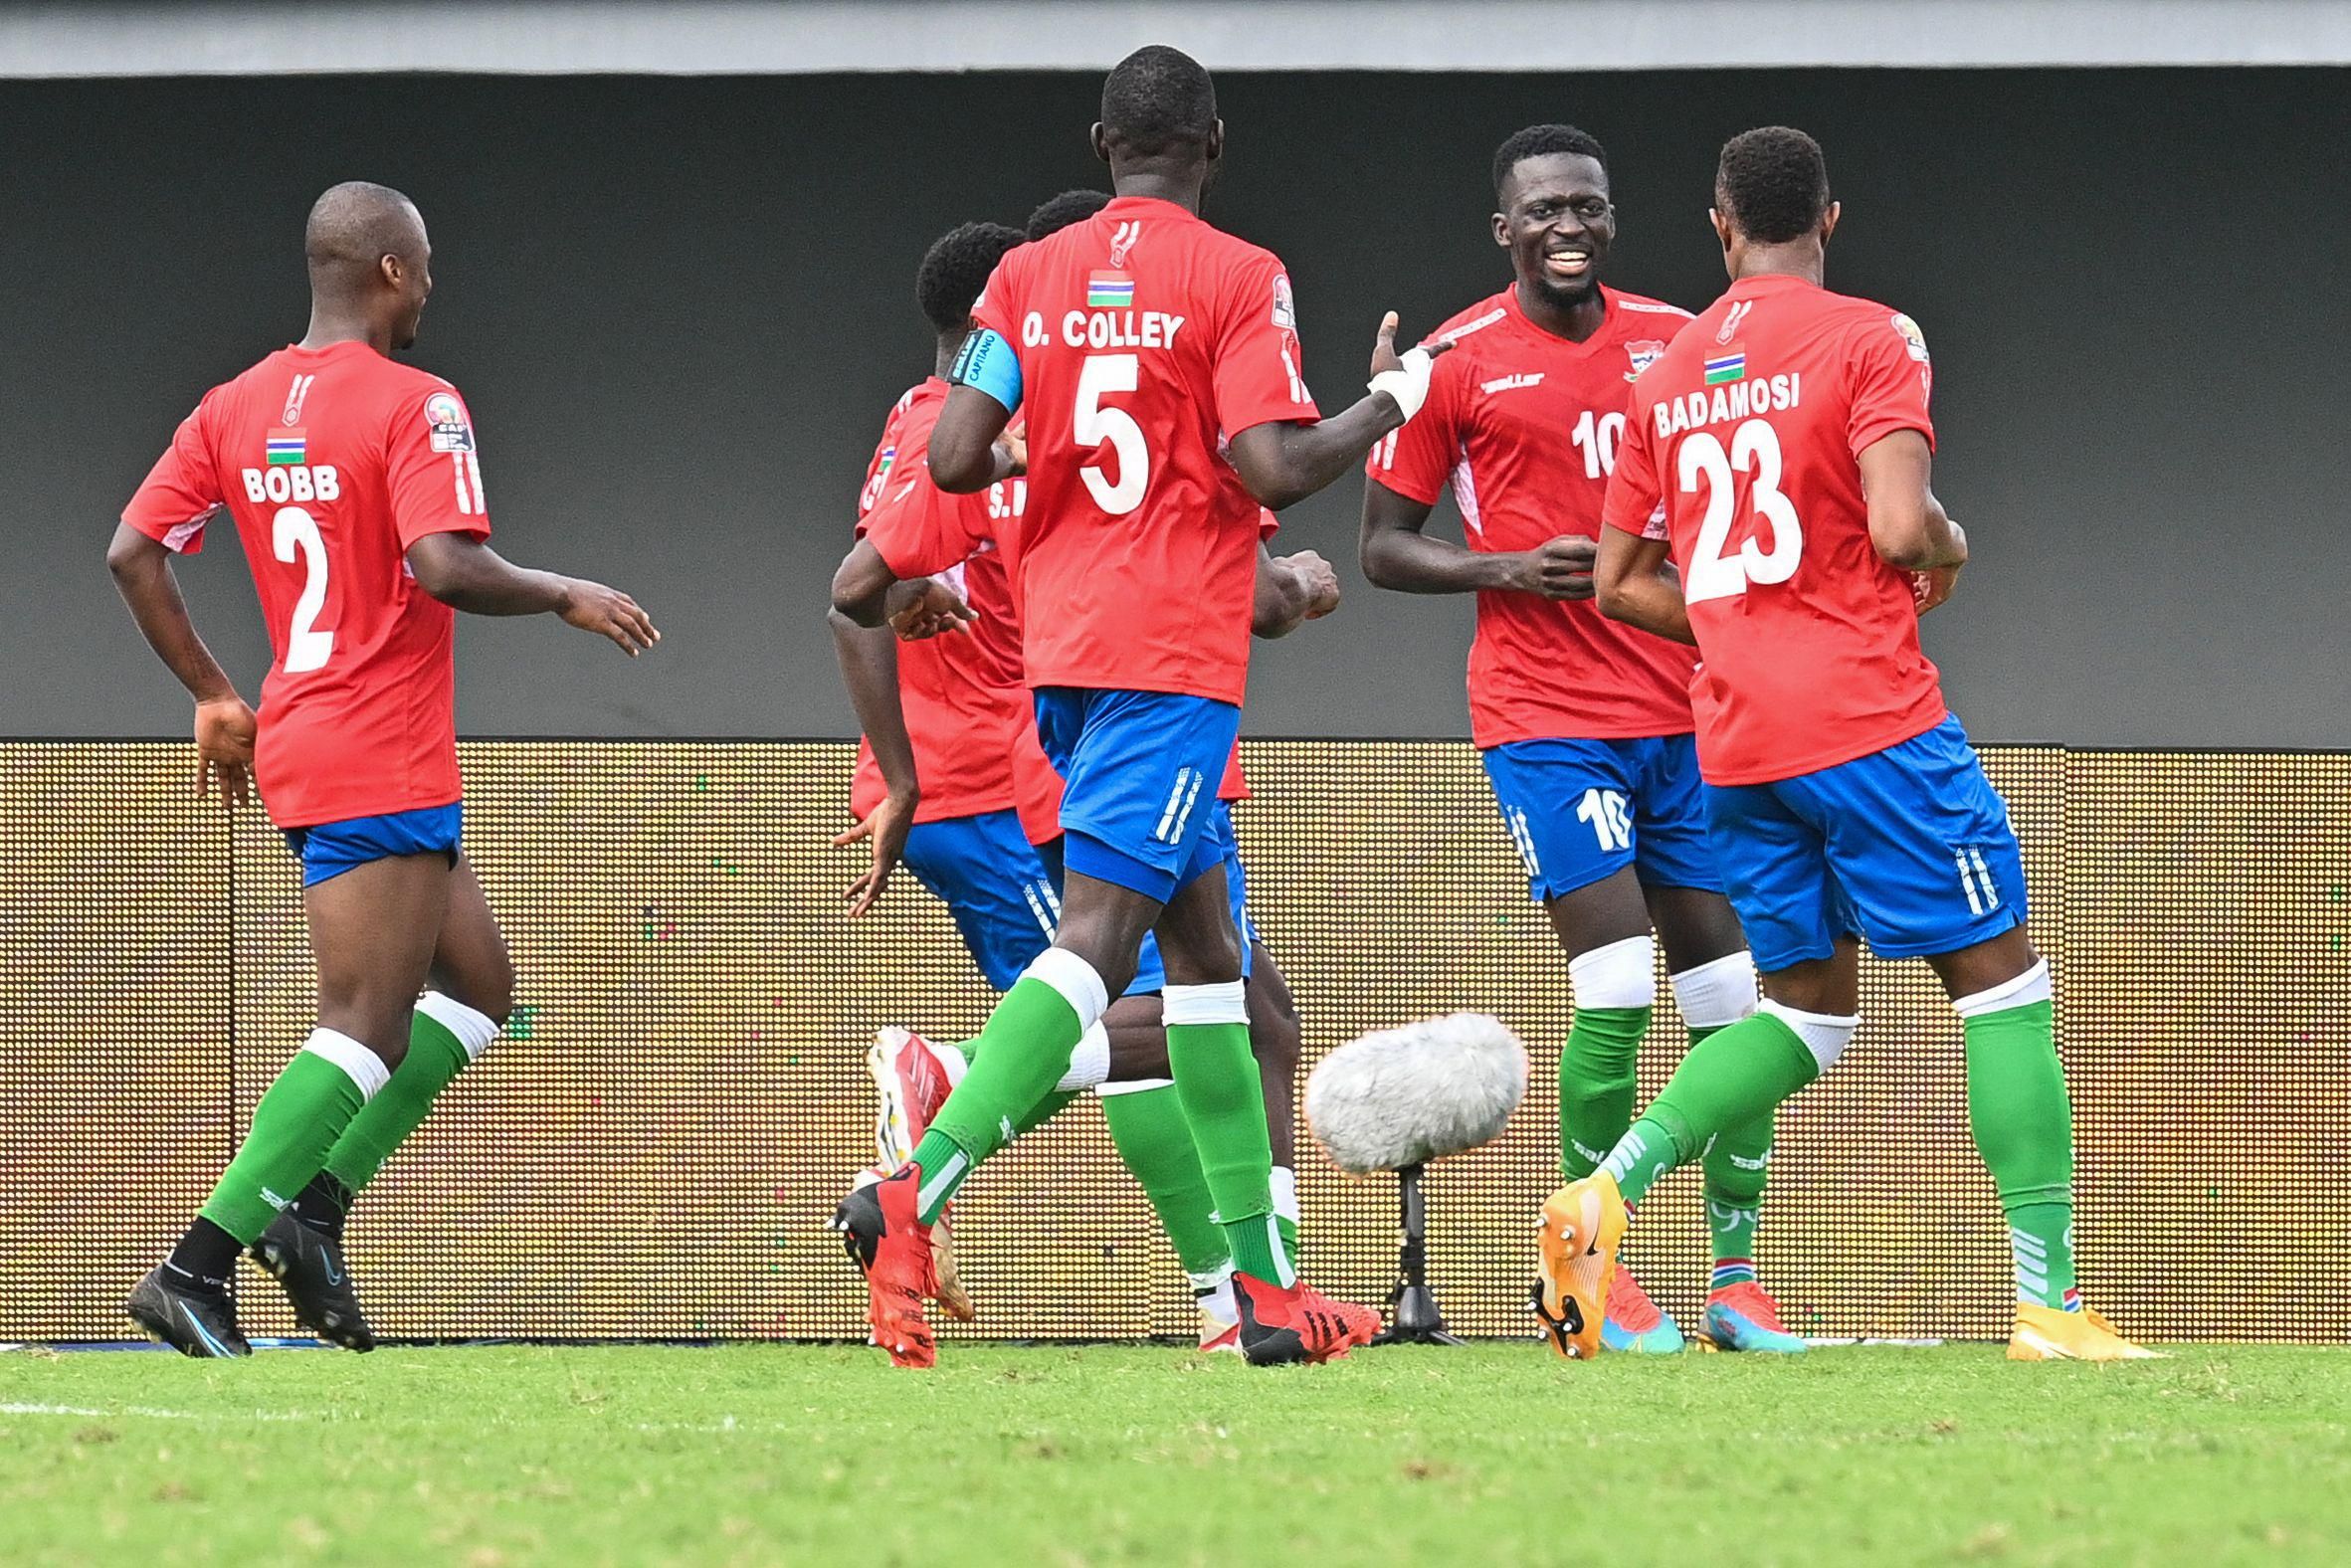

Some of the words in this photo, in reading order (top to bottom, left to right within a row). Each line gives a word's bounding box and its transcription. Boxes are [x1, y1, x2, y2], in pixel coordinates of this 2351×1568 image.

[969, 334, 995, 381] CAPITANO
[1022, 310, 1050, 347] O.
[1062, 309, 1185, 349] COLLEY
[1073, 353, 1149, 514] 5
[1654, 372, 1800, 438] BADAMOSI
[1572, 410, 1626, 479] 10
[242, 465, 340, 503] BOBB
[1677, 418, 1804, 605] 23
[272, 505, 334, 674] 2
[1576, 788, 1632, 852] 10
